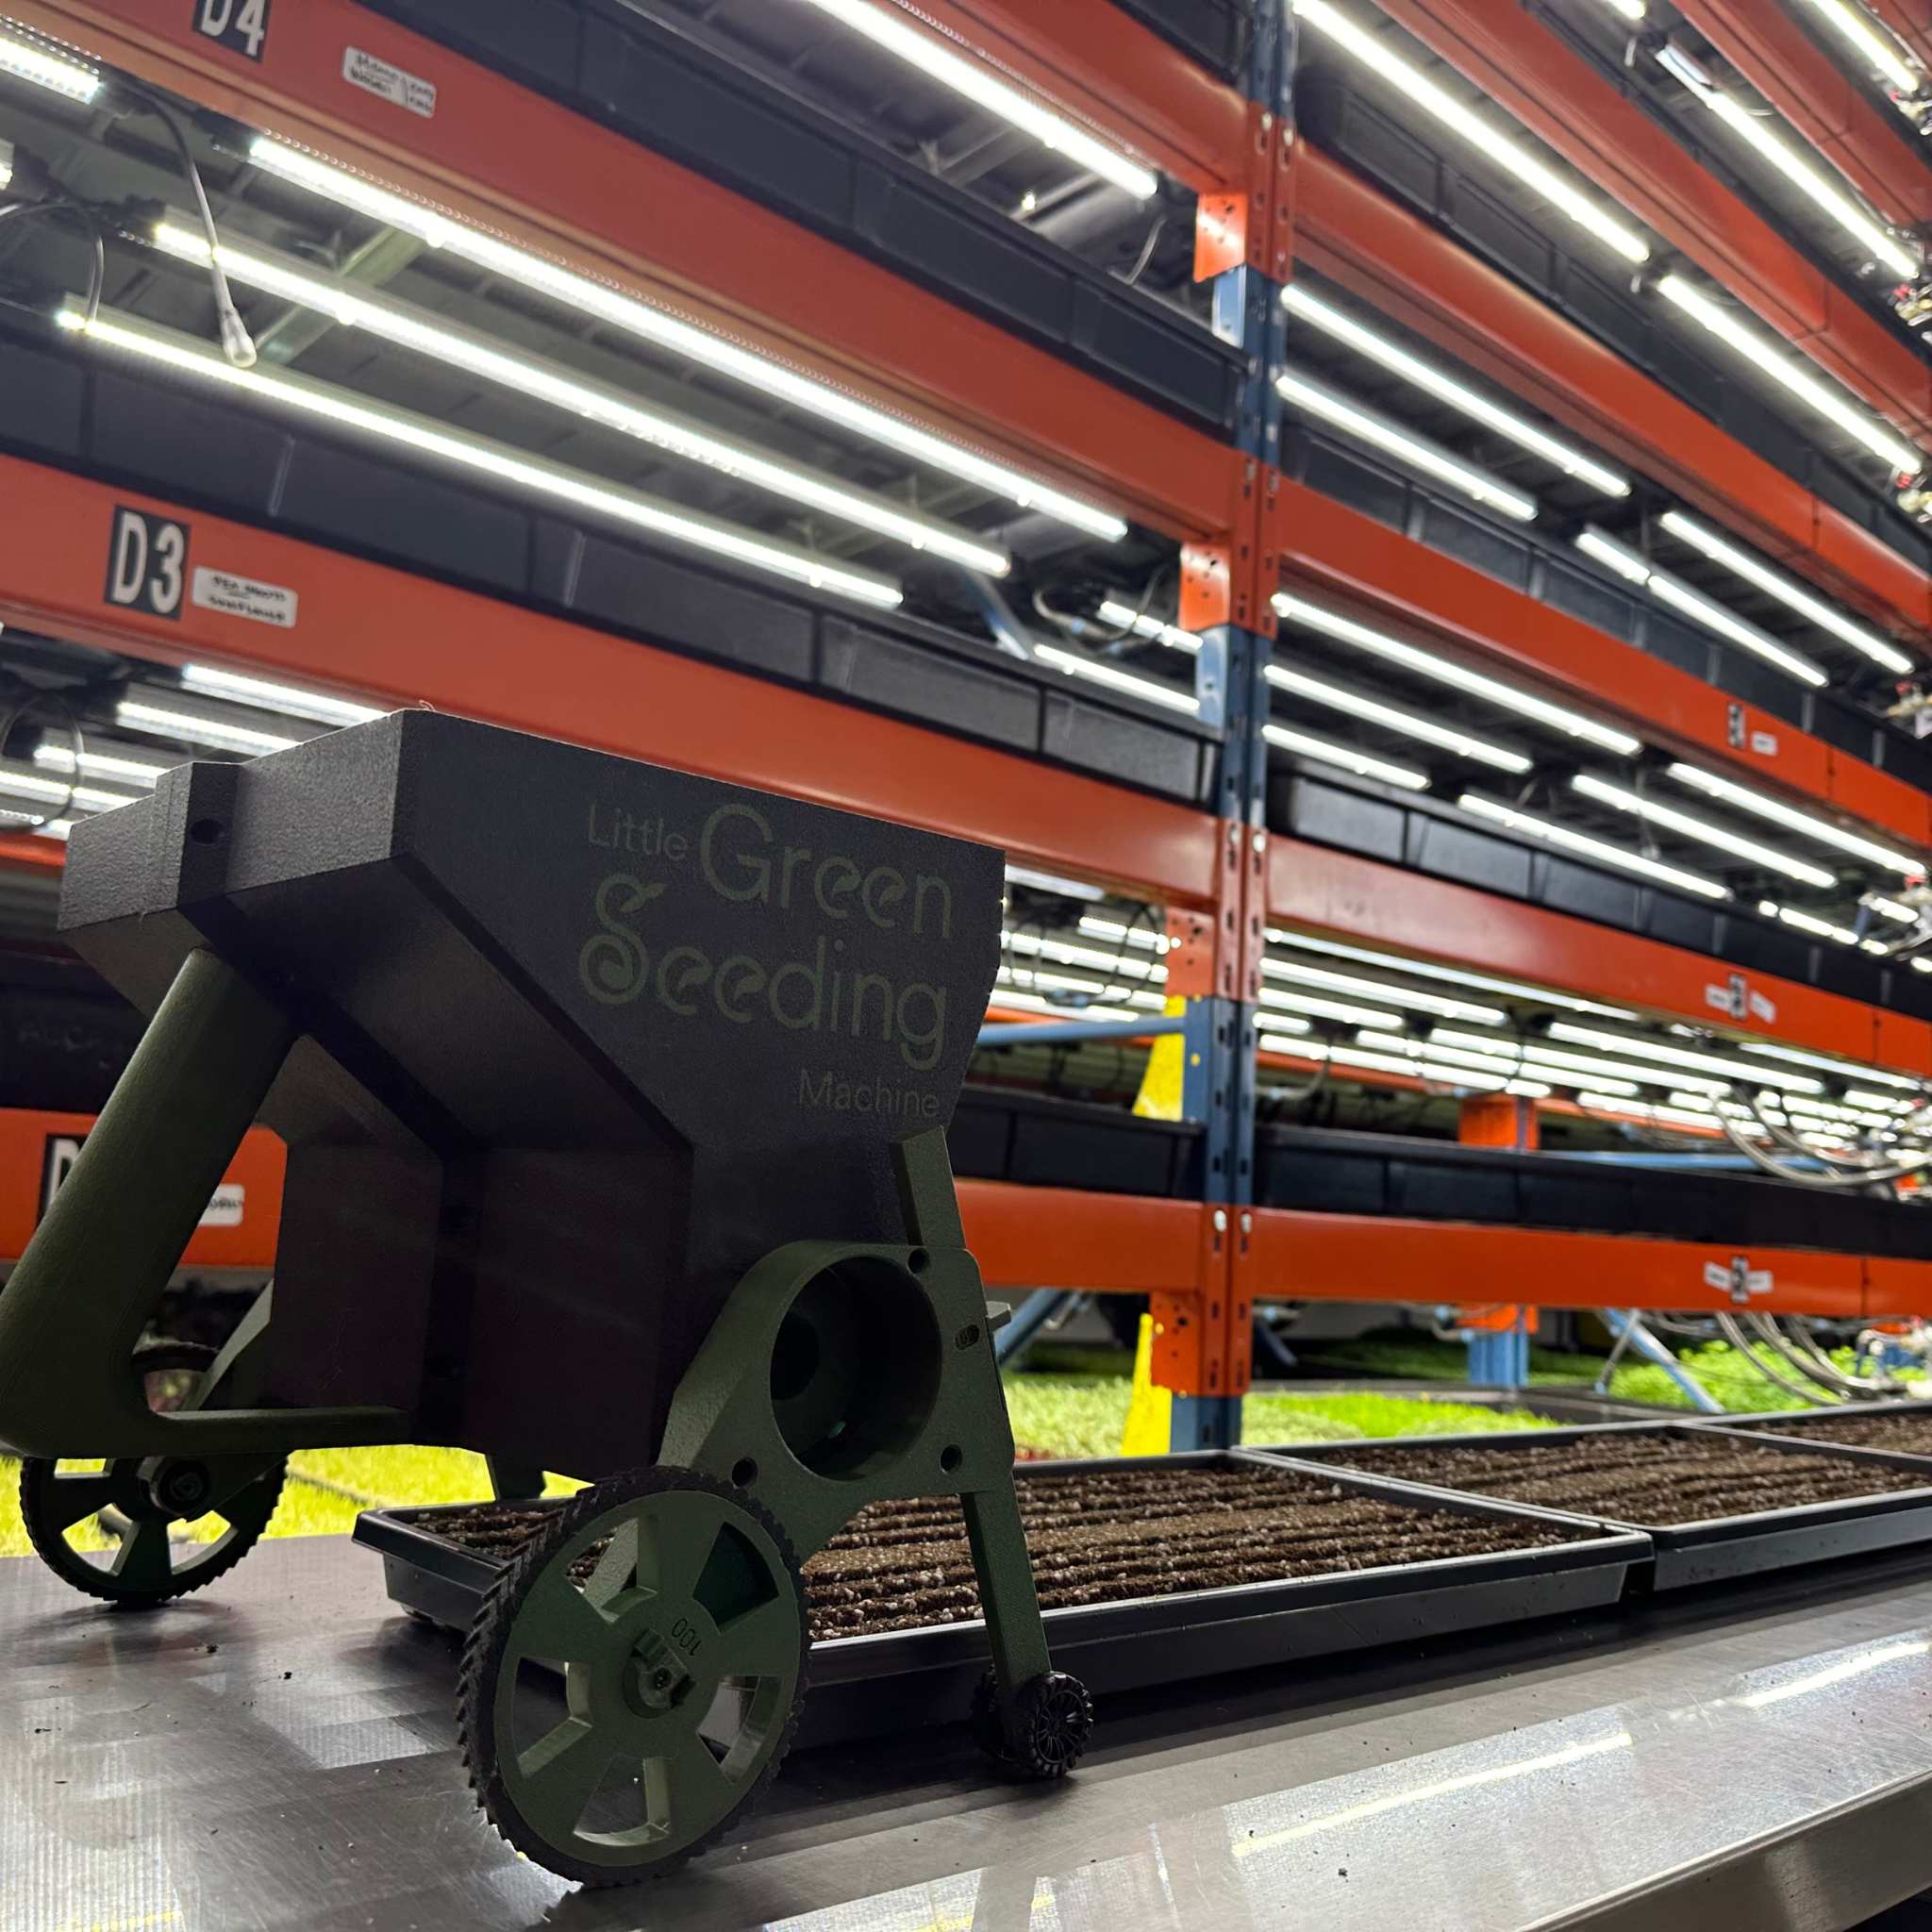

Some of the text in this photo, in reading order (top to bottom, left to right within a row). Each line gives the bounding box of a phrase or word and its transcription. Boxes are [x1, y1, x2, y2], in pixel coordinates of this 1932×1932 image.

[112, 510, 185, 613] D3
[587, 802, 952, 939] Little Green
[578, 873, 947, 1071] Seeding
[798, 1069, 940, 1118] Machine
